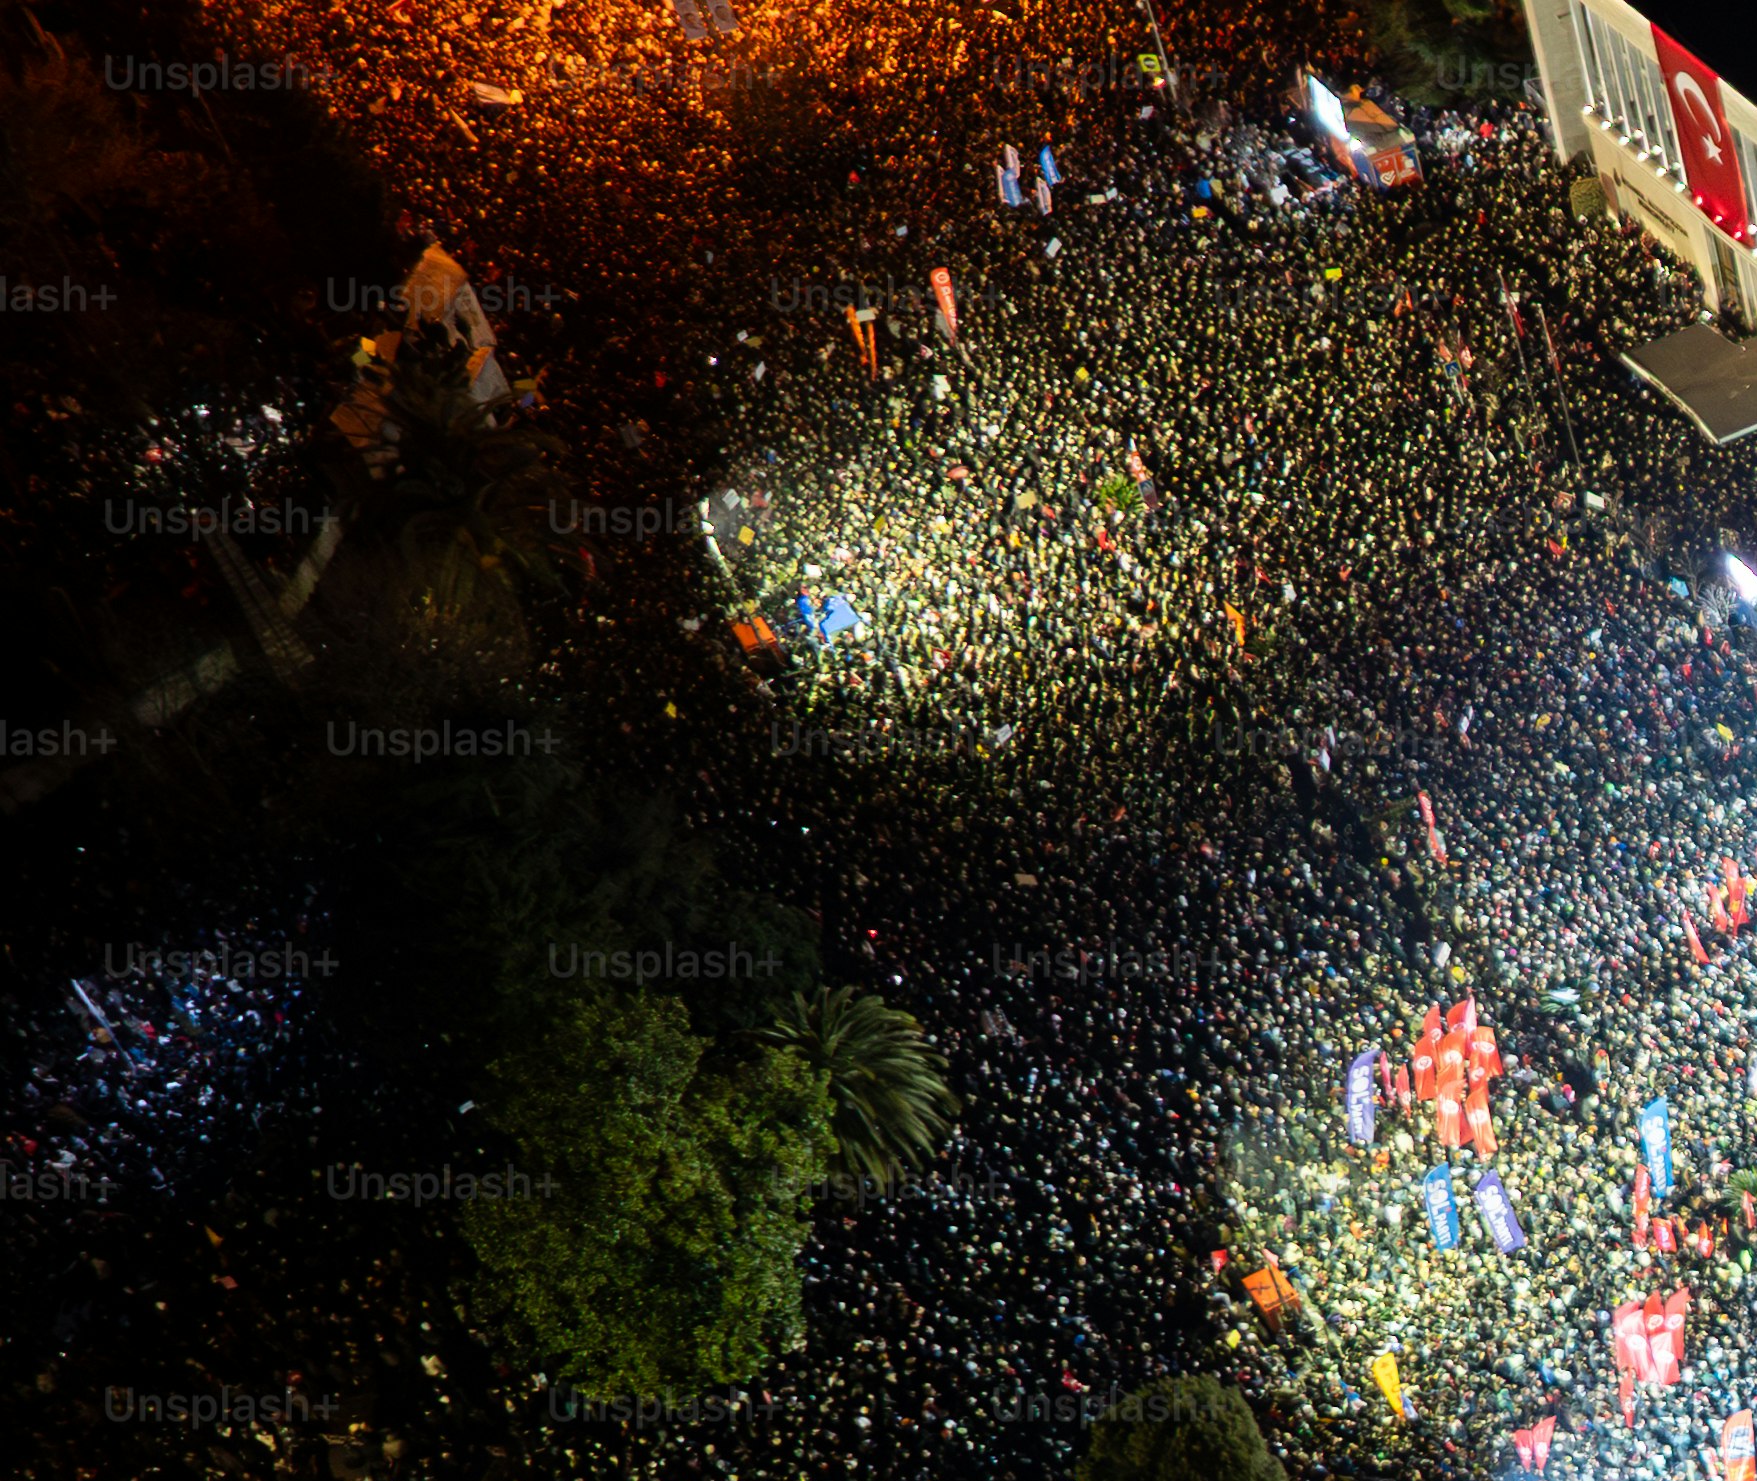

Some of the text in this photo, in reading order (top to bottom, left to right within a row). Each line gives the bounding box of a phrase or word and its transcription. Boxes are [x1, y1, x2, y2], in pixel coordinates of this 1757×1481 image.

[1350, 1065, 1370, 1103] SOL
[1643, 1116, 1667, 1158] SOL
[1428, 1179, 1450, 1220] SOL
[1482, 1184, 1508, 1224] SOL
